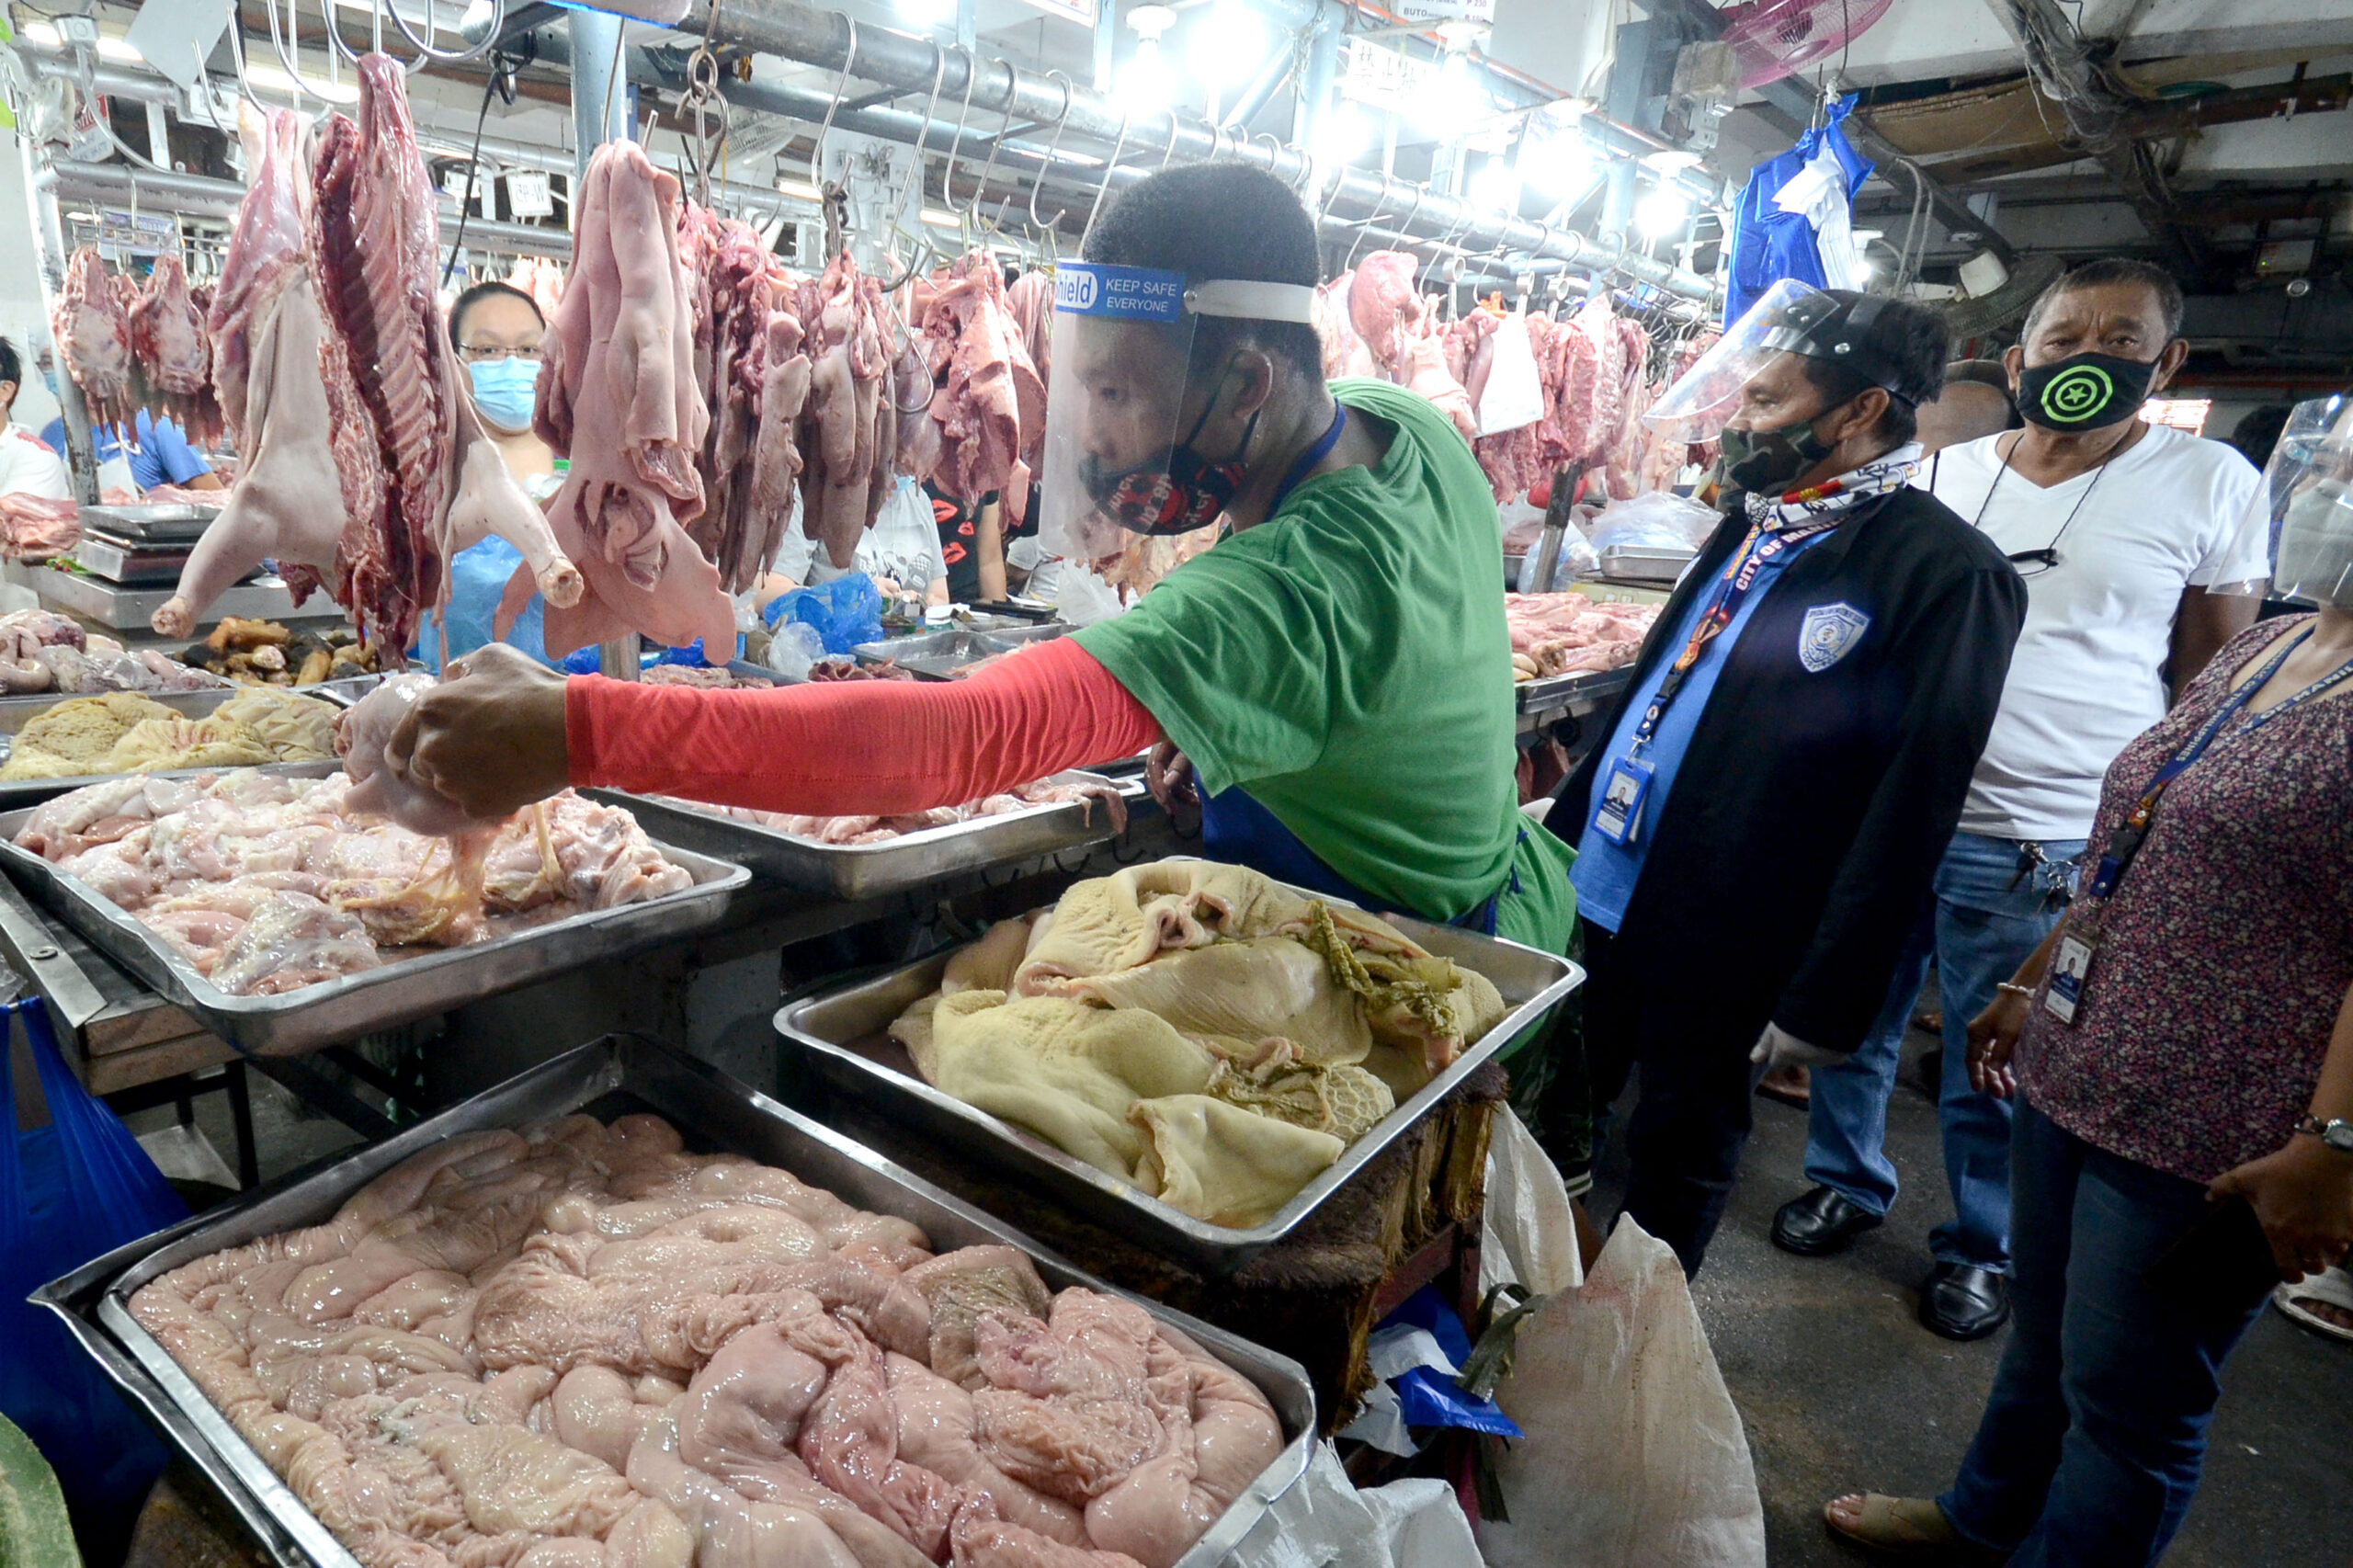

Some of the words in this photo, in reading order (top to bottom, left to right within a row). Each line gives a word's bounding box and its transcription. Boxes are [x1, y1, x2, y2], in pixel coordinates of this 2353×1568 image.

[1055, 273, 1093, 303] hield
[1106, 278, 1141, 293] KEEP
[1142, 281, 1177, 297] SAFE
[1107, 296, 1169, 312] EVERYONE
[1735, 553, 1762, 591] CITY
[1759, 539, 1782, 557] OF
[2259, 701, 2288, 720] OF
[2176, 709, 2225, 762] PHILIPPINES
